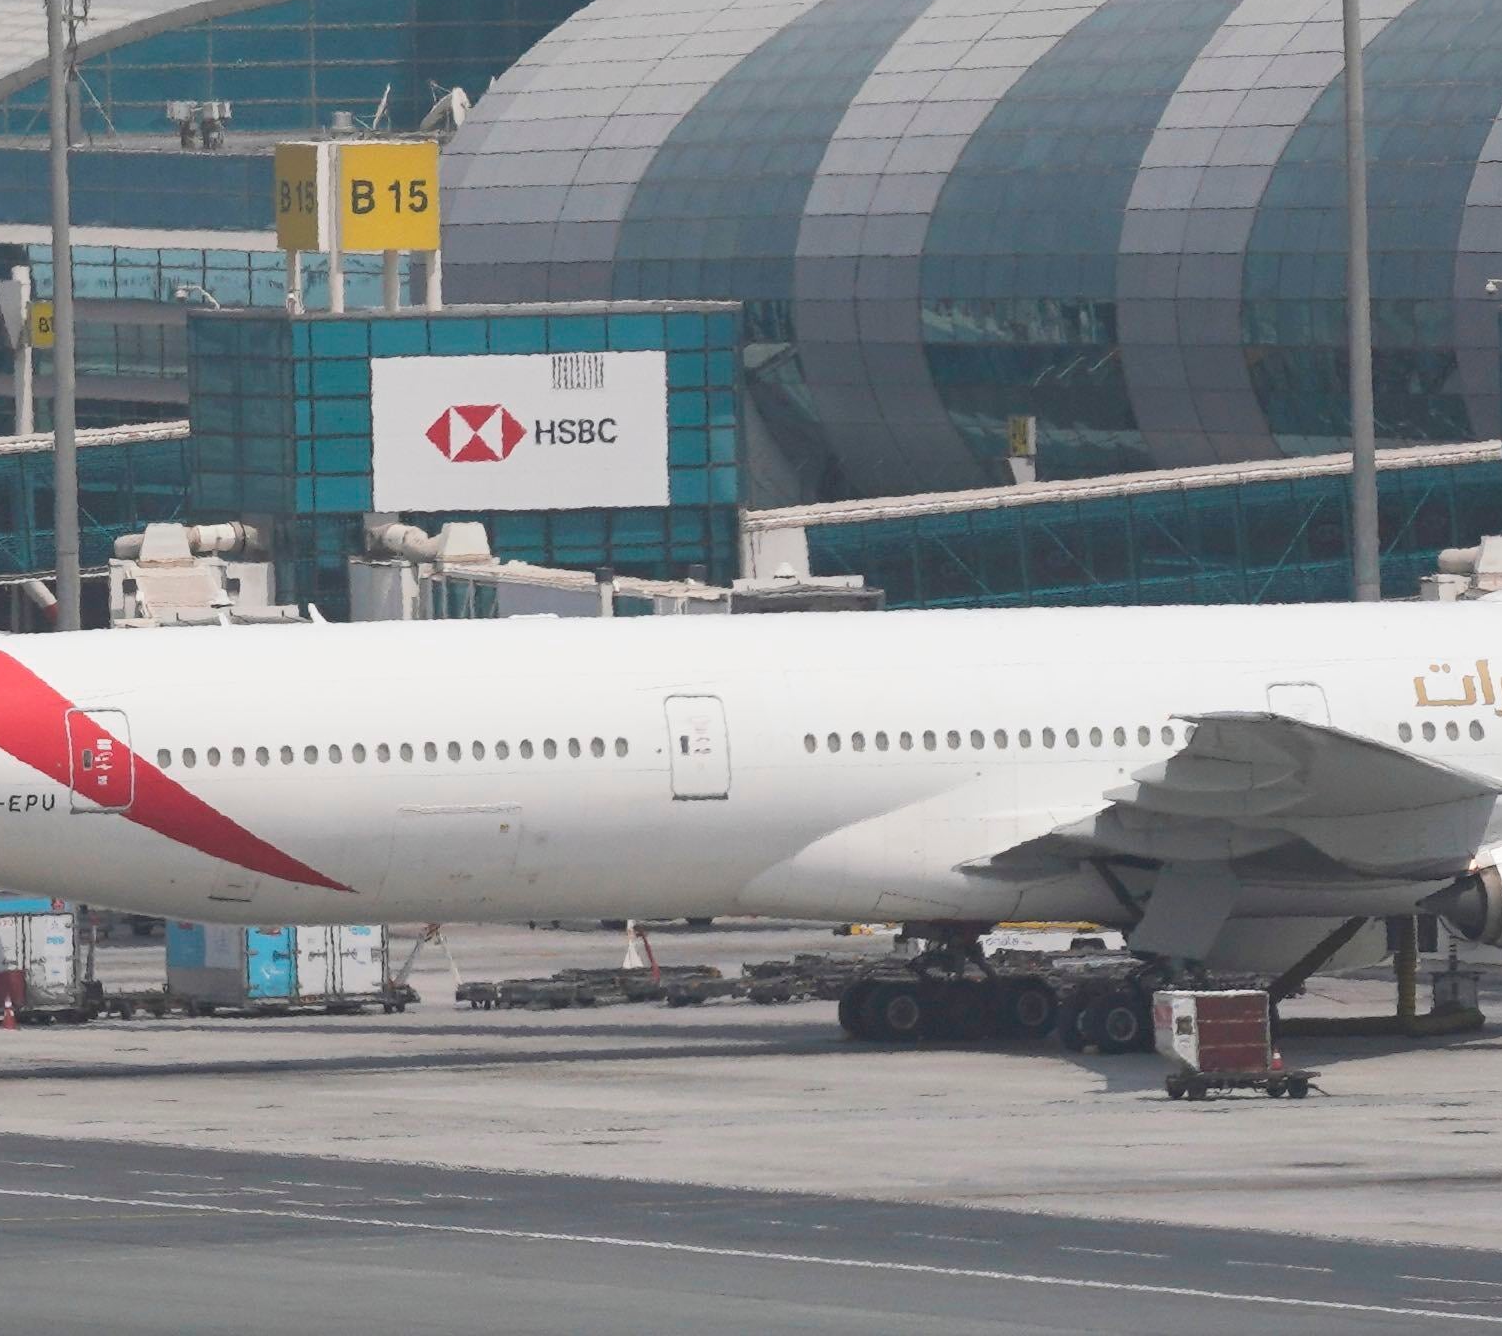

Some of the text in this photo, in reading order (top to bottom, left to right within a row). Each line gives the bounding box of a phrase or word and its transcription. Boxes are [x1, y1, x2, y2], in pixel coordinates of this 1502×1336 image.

[351, 179, 428, 215] B 15
[535, 417, 618, 445] HSBC
